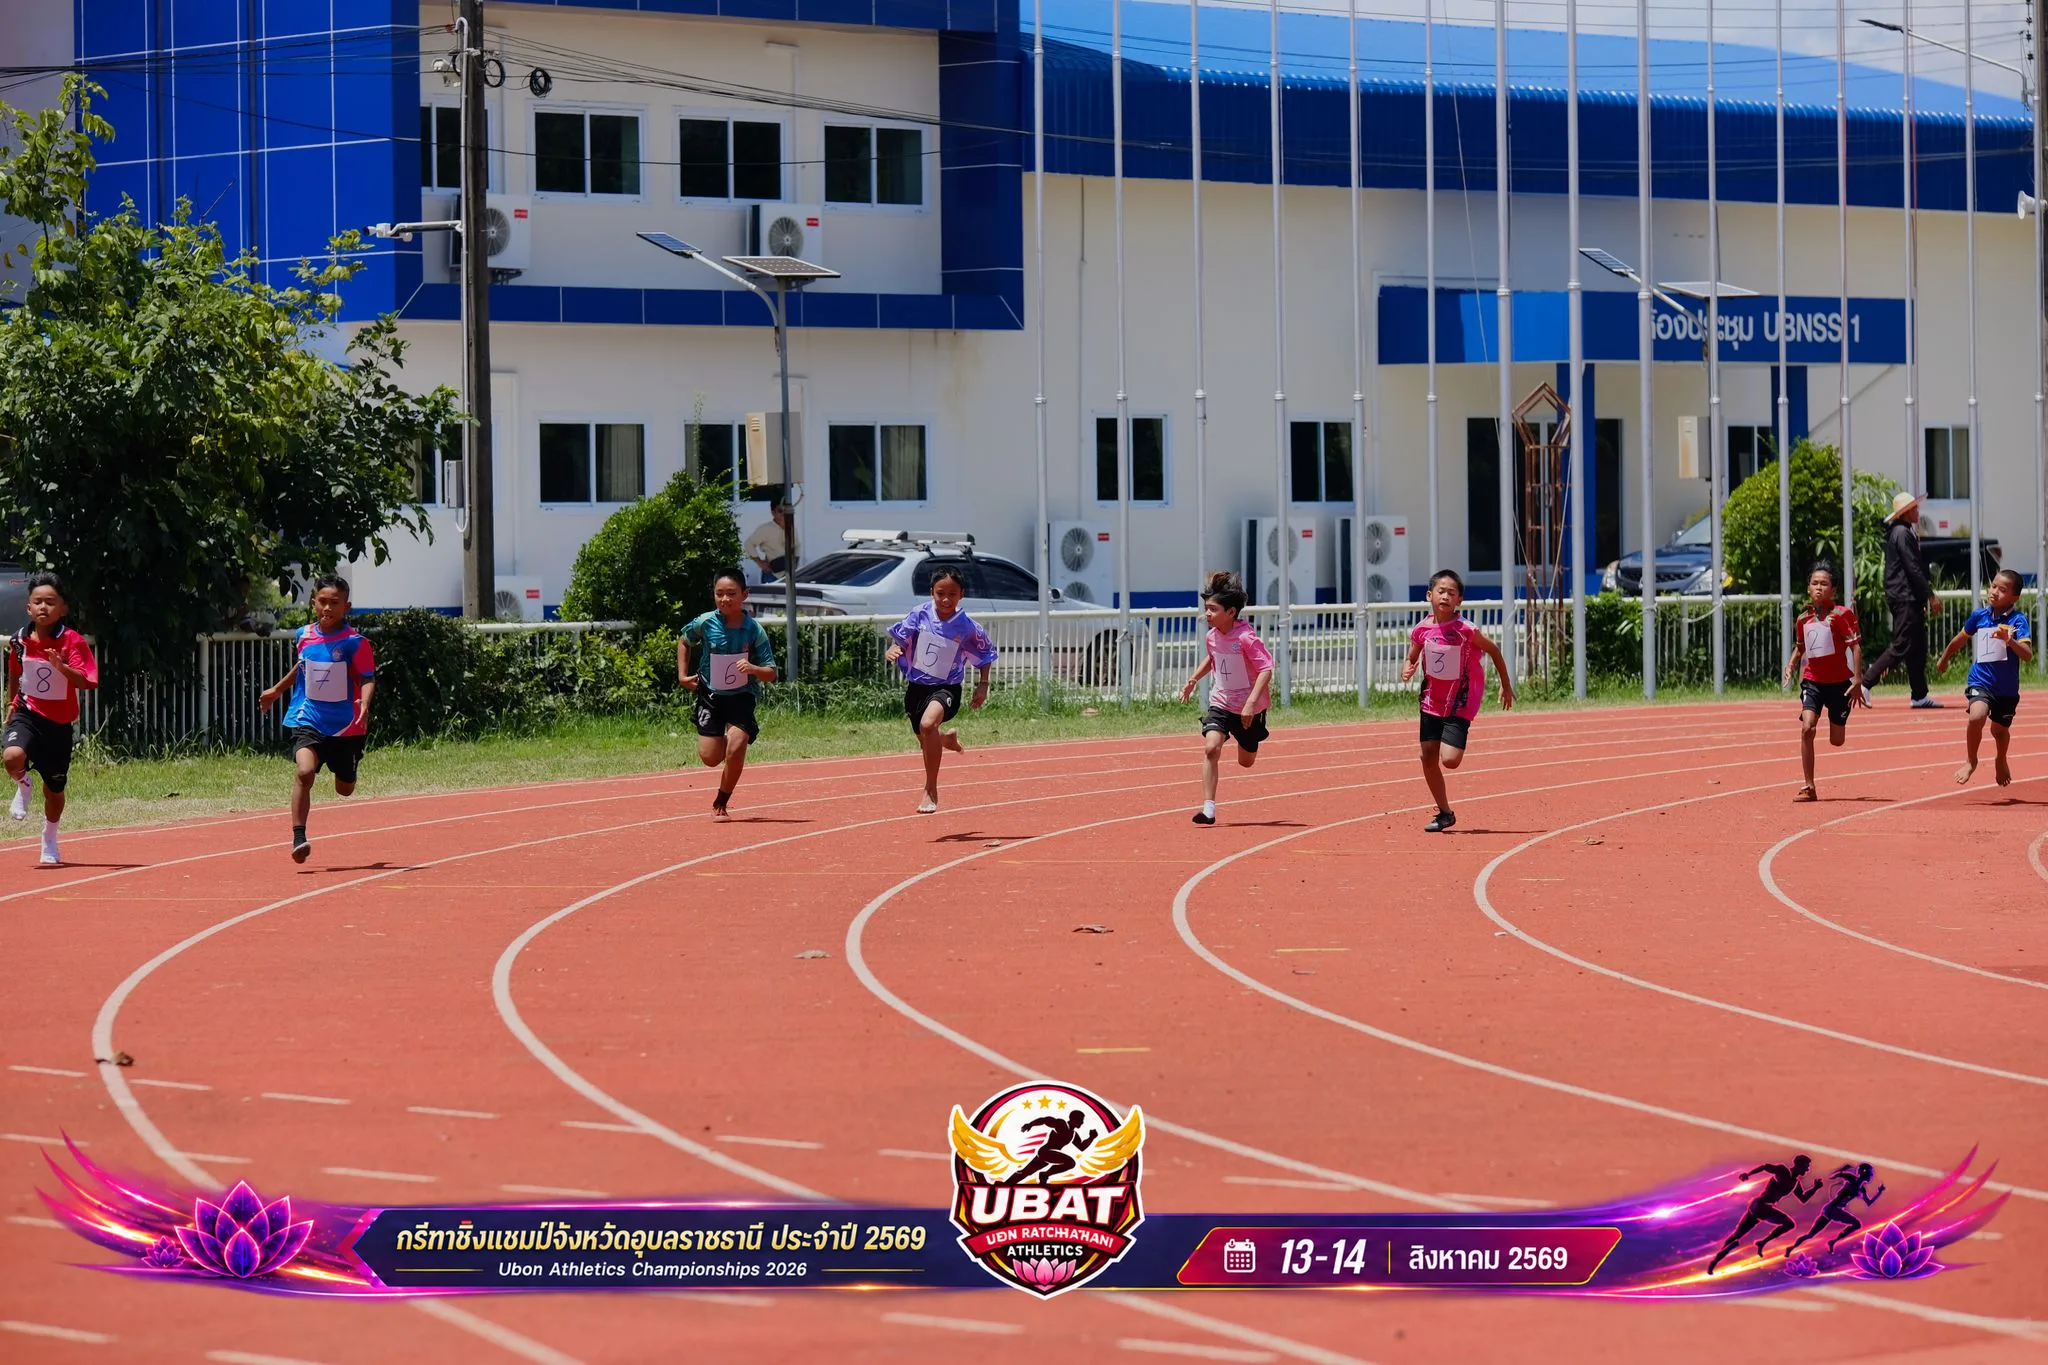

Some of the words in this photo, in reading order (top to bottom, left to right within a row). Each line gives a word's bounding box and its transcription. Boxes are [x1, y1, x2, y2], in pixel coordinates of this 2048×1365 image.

[1850, 313, 1860, 343] 1
[1806, 629, 1822, 651] 2
[1981, 632, 1995, 657] 1
[923, 643, 941, 668] 5
[1431, 651, 1446, 674] 3
[36, 667, 52, 693] 8
[313, 669, 331, 691] 7
[724, 662, 737, 685] 6
[1220, 659, 1232, 681] 4
